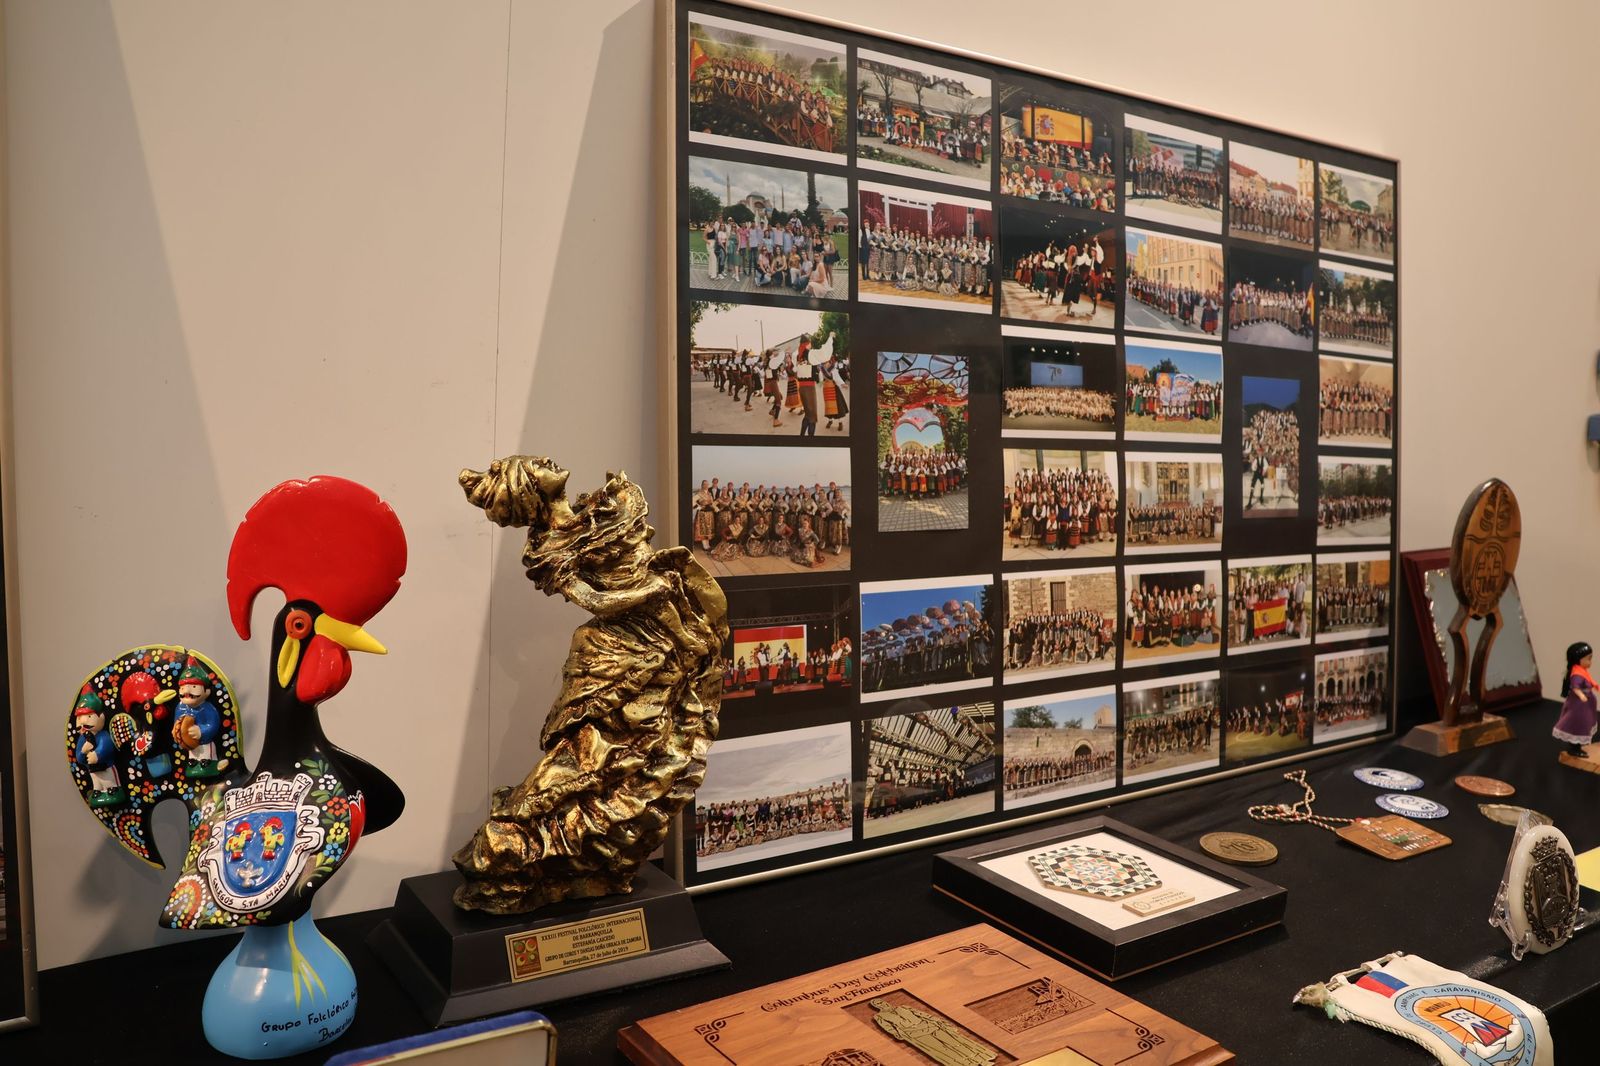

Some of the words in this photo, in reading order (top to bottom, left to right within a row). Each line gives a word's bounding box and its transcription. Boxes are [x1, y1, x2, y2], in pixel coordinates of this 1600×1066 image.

[556, 928, 578, 939] FESTIVAL
[606, 915, 640, 928] INTERNACIONAL
[572, 934, 580, 942] DE
[579, 927, 613, 941] BARRANQUILLA
[544, 954, 558, 962] GRUPO
[626, 935, 642, 945] ZAMORA
[617, 946, 629, 954] 2019
[760, 986, 830, 1013] Columbus
[828, 977, 861, 993] Day
[863, 957, 936, 981] Celebration
[814, 994, 848, 1006] San
[845, 977, 902, 998] Francisco
[1433, 987, 1501, 1003] CARAVANISMO
